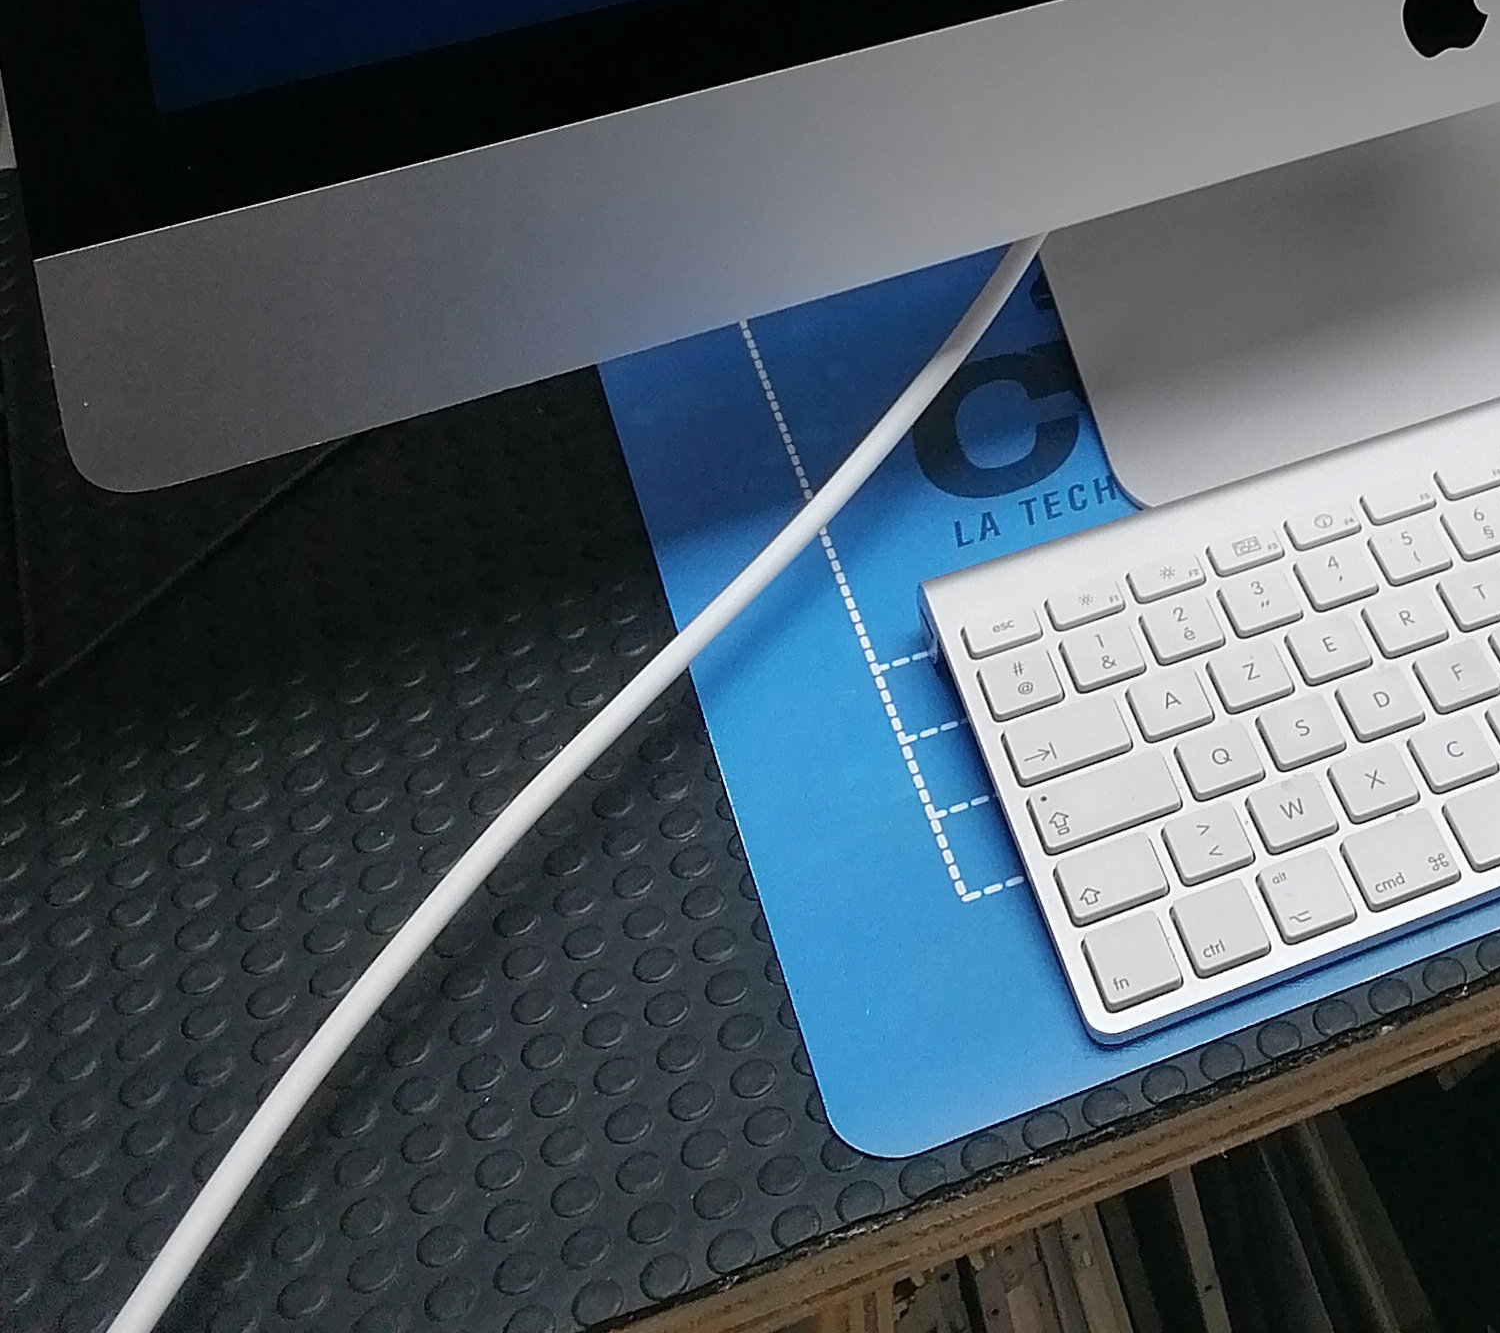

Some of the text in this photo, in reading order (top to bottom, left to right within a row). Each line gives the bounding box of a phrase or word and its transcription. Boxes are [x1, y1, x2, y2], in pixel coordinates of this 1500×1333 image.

[954, 511, 1001, 549] LA
[992, 619, 1015, 633] esc
[1272, 871, 1288, 885] alt
[1375, 871, 1406, 895] cmd
[1202, 939, 1226, 959] ctrl
[1113, 976, 1130, 991] fn
